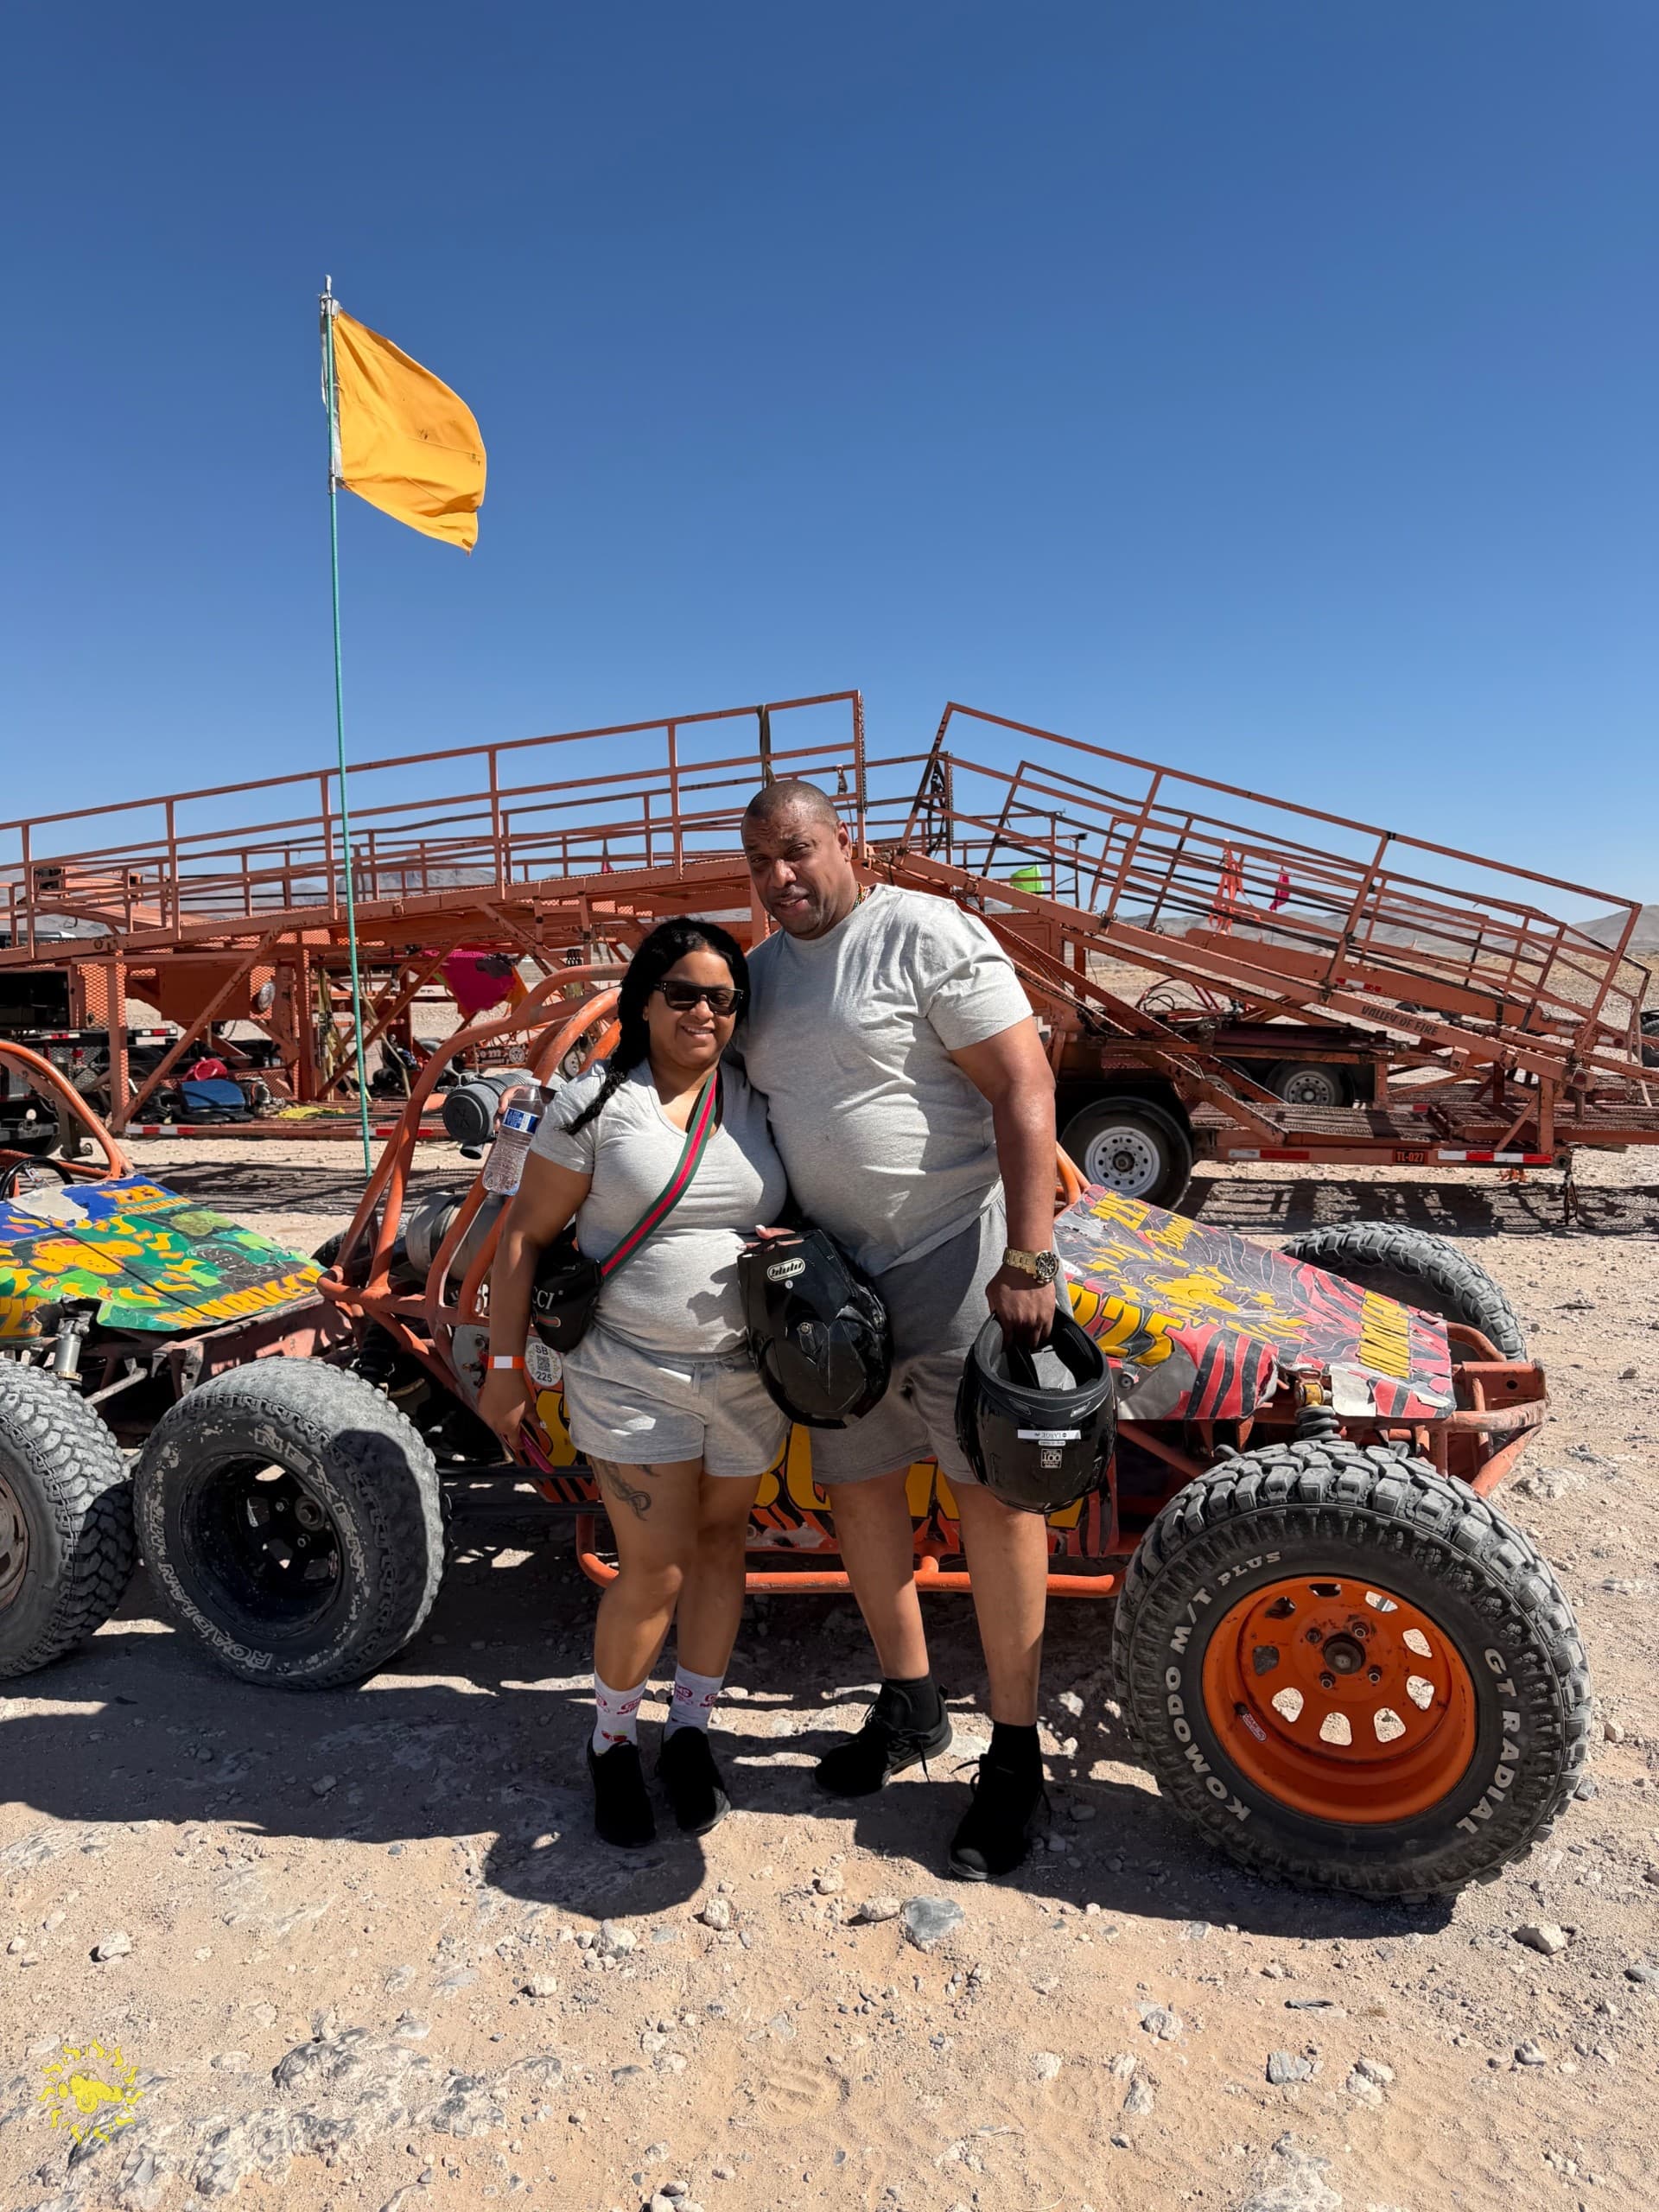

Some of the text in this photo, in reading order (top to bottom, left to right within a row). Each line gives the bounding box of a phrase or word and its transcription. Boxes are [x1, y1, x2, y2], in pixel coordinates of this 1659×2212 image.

[1361, 1006, 1439, 1035] VALLEY OF FIRE
[1396, 1151, 1424, 1162] TL-027
[536, 1345, 549, 1356] SB
[537, 1371, 552, 1382] 225
[159, 1563, 273, 1669] ROADIAN
[1166, 1551, 1281, 1822] KOMODO M/T PLUS
[1456, 1647, 1521, 1835] GT RADIAL
